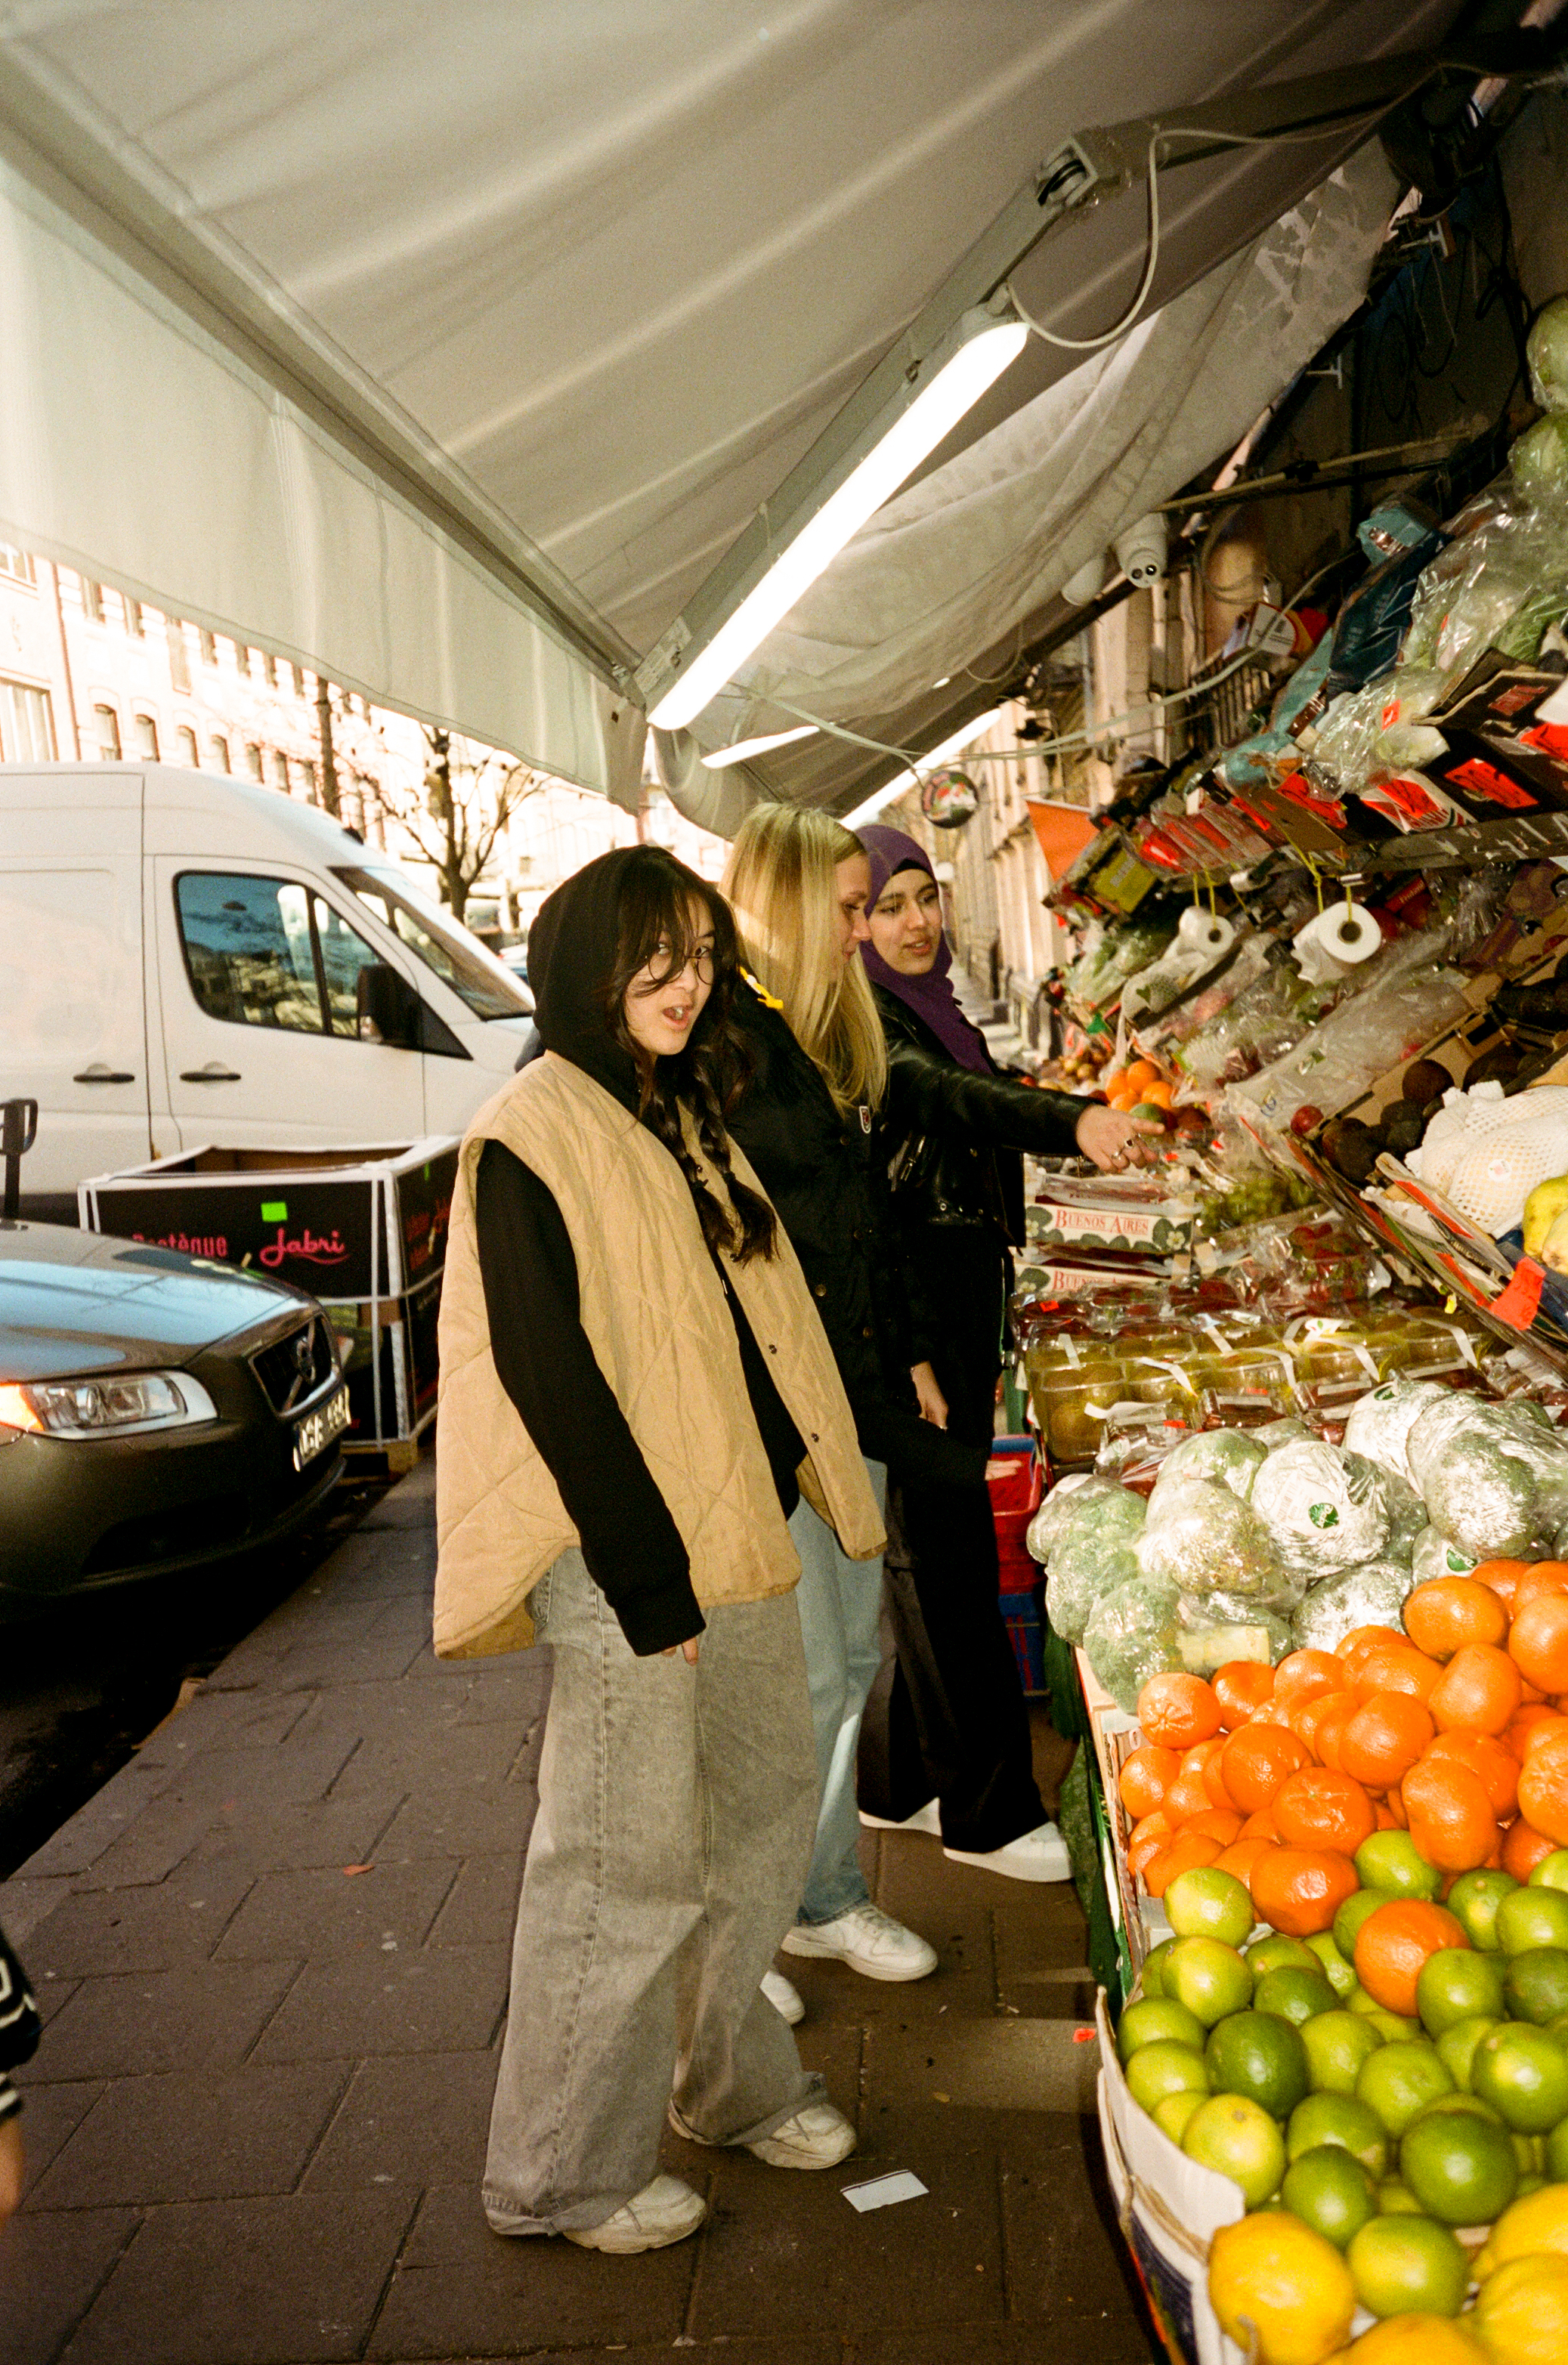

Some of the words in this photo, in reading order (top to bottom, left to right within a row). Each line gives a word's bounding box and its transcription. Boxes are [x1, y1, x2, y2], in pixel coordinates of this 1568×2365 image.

[1055, 1209, 1106, 1229] BUENOS
[1110, 1215, 1149, 1235] AIRES
[259, 1227, 350, 1267] Jabri
